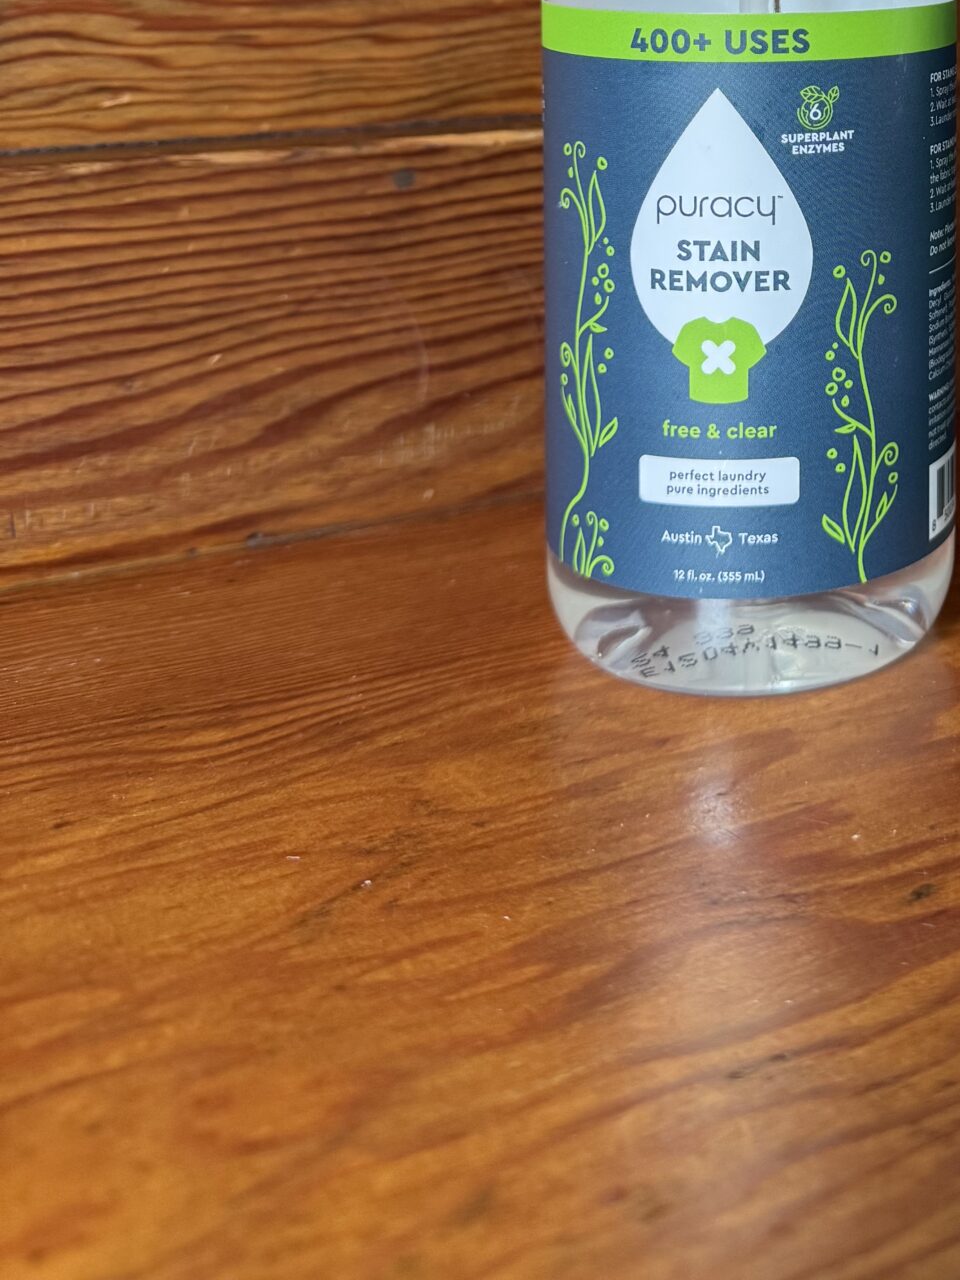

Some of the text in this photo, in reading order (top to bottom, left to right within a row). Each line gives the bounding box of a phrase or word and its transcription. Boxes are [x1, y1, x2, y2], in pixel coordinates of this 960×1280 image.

[631, 28, 810, 54] 400+ USES
[810, 105, 821, 120] 6
[781, 130, 854, 144] SUPERPLANT
[792, 142, 845, 154] ENZYMES
[677, 240, 760, 261] STAIN
[651, 269, 791, 292] REMOVER
[663, 420, 777, 439] free & clear
[669, 470, 766, 484] perfect laundry
[667, 484, 769, 496] pure ingredients
[662, 530, 778, 544] Austin Texas
[674, 570, 764, 583] 12 fl. oz. (355 mL)
